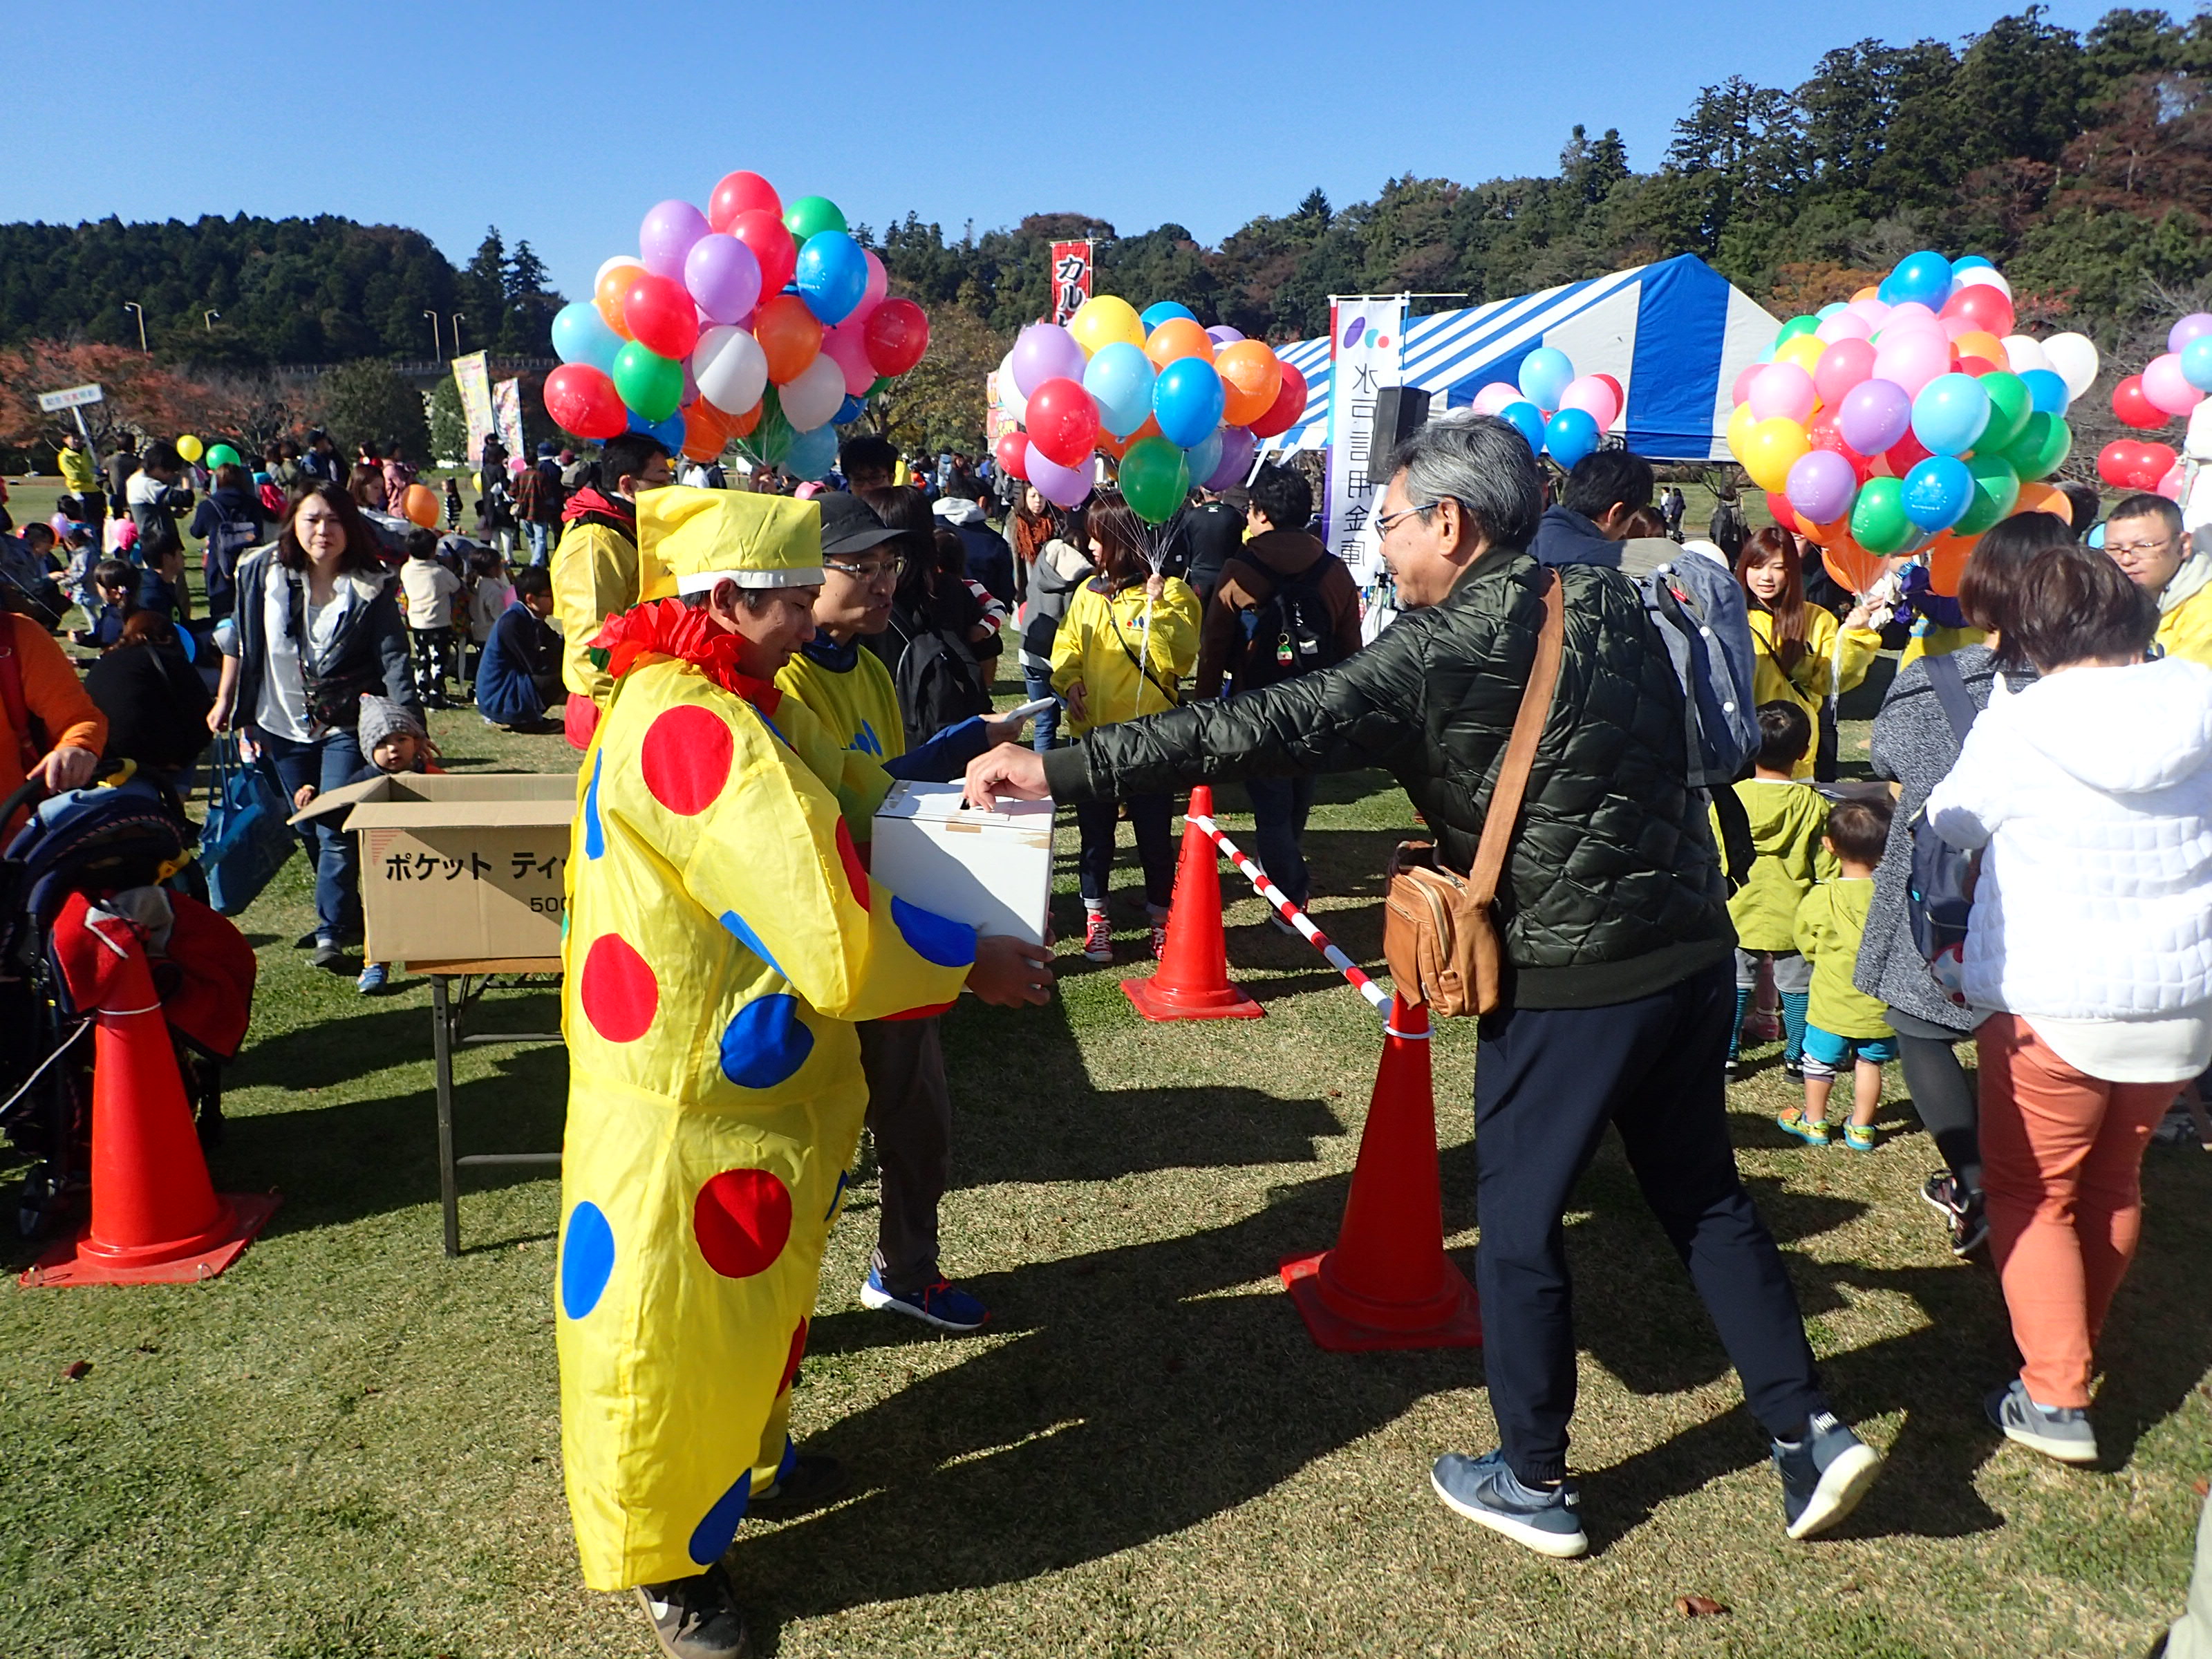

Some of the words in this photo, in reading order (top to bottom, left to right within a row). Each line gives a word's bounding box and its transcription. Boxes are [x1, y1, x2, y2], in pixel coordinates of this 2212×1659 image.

[386, 852, 492, 881] ポケット
[512, 852, 566, 879] ティ
